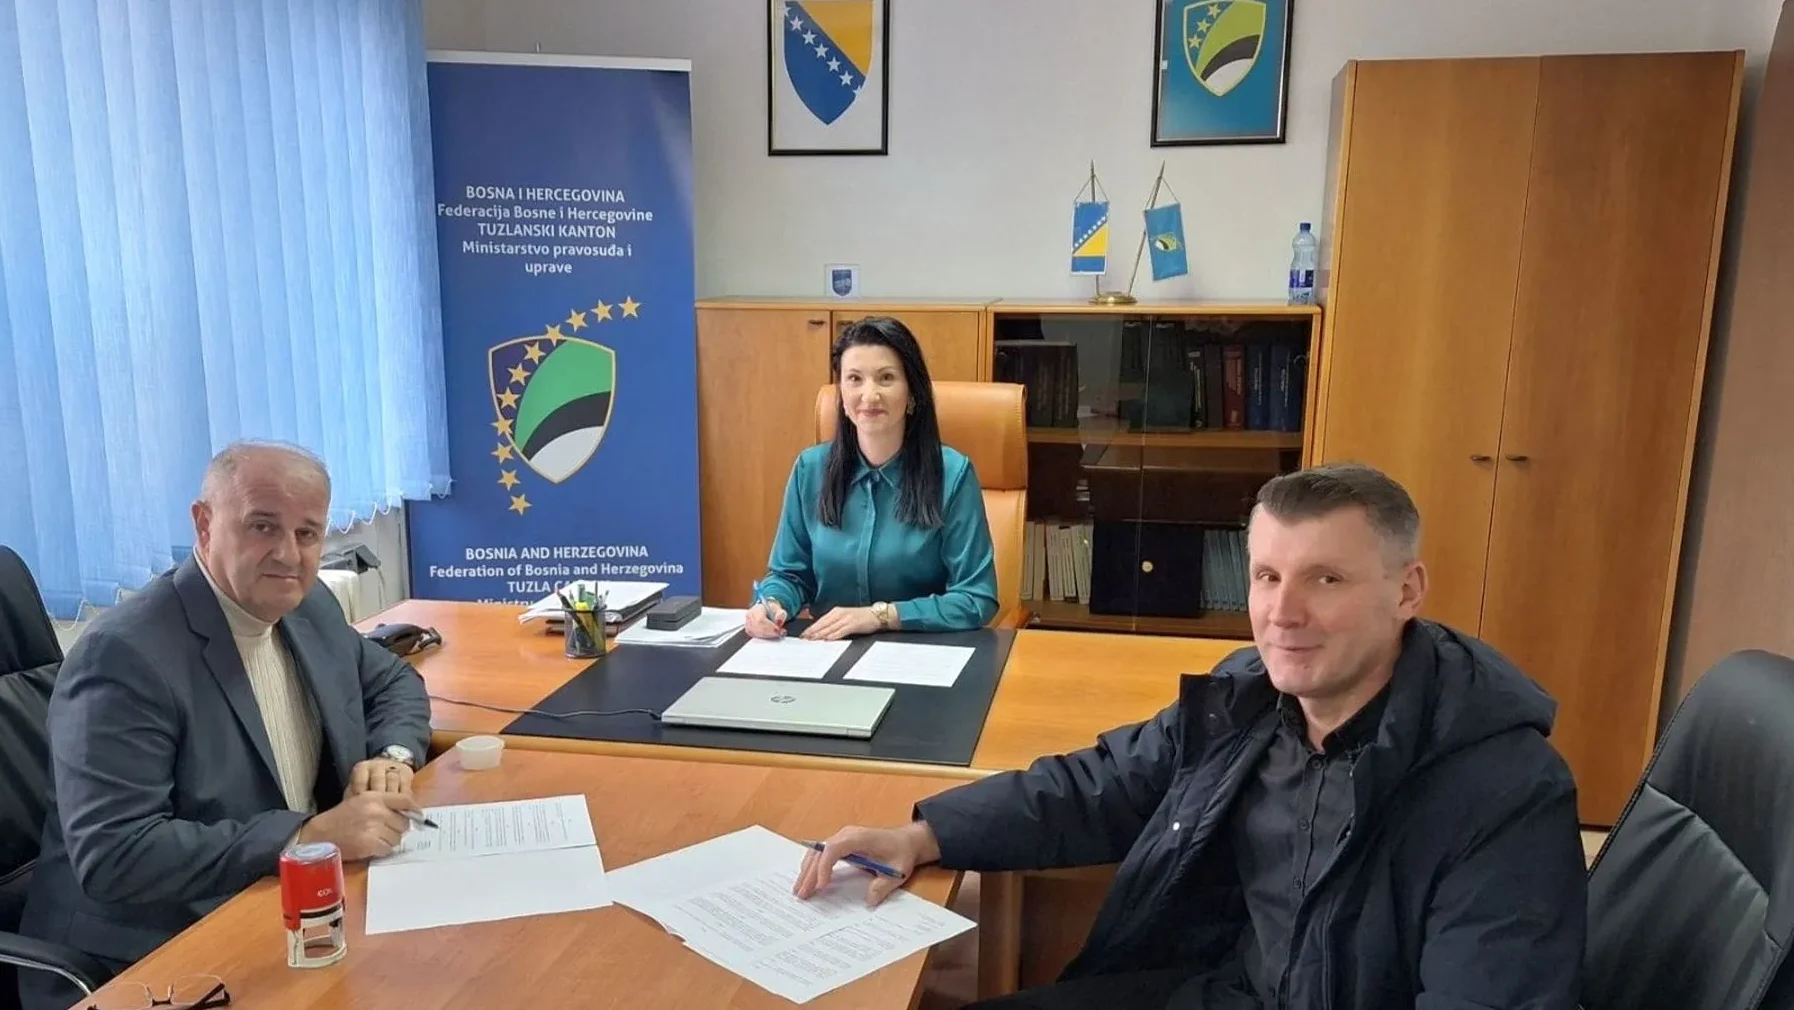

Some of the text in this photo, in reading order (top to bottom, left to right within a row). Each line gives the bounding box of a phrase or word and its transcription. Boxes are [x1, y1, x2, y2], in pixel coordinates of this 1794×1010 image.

[466, 186, 625, 203] BOSNA I HERCEGOVINA
[437, 203, 653, 224] Federacija Bosne i Hercegovine
[477, 222, 616, 238] TUZLANSKI KANTON
[462, 241, 550, 255] Ministarstvo
[627, 244, 632, 256] i
[525, 262, 572, 275] uprave
[466, 545, 649, 560] BOSNIA AND HERZEGOVINA
[430, 562, 684, 578] Federation of Bosnia and Herzegovina
[507, 581, 551, 594] TUZLA
